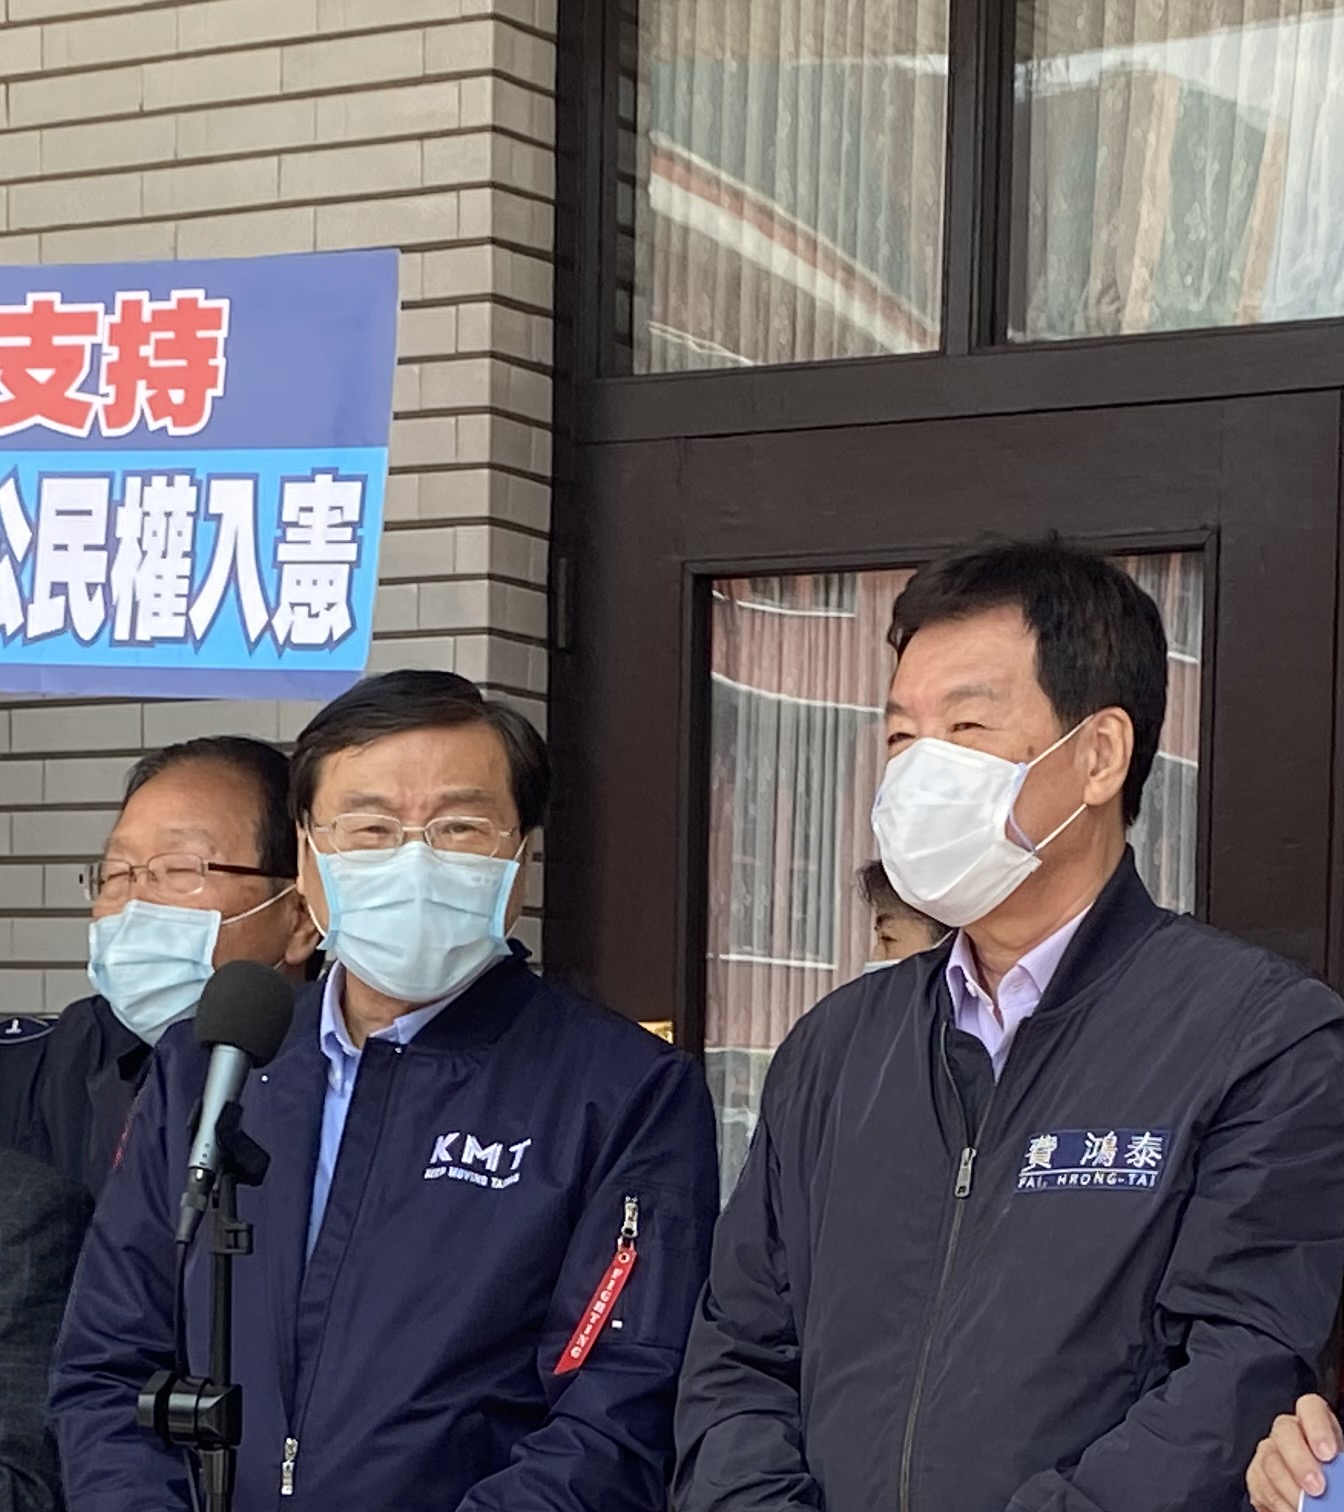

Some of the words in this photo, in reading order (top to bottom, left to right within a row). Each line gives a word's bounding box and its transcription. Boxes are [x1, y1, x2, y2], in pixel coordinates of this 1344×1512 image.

[429, 1132, 532, 1172] KMT
[1021, 1131, 1164, 1172] 費鴻泰
[569, 1267, 623, 1359] FIGHTING
